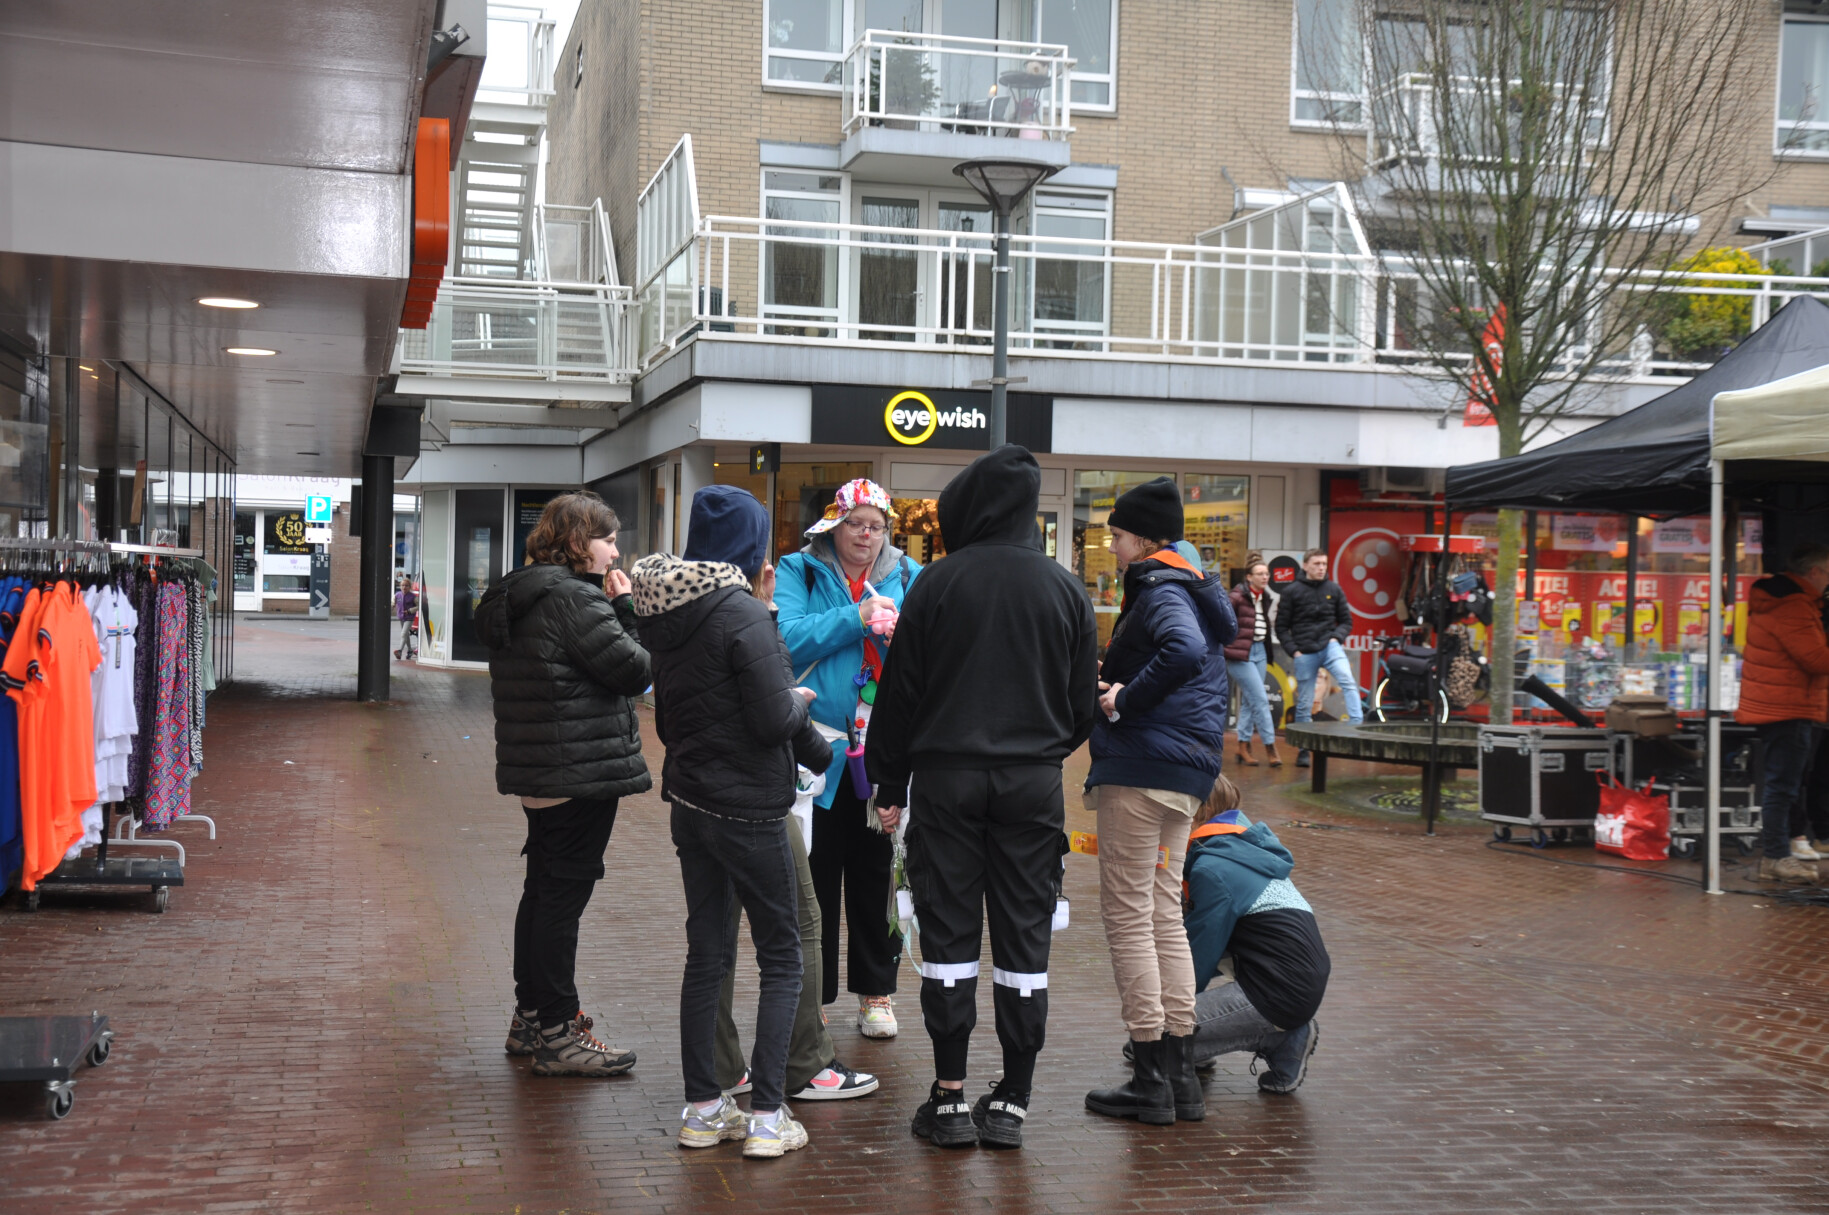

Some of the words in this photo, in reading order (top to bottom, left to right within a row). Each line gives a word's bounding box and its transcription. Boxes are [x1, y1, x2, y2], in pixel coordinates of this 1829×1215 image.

[891, 408, 930, 431] eye
[936, 406, 986, 429] wish
[311, 498, 327, 519] P
[286, 521, 303, 532] 50
[1598, 579, 1658, 598] ACIE!
[937, 1104, 955, 1115] STEVE
[989, 1101, 1005, 1111] STEVE
